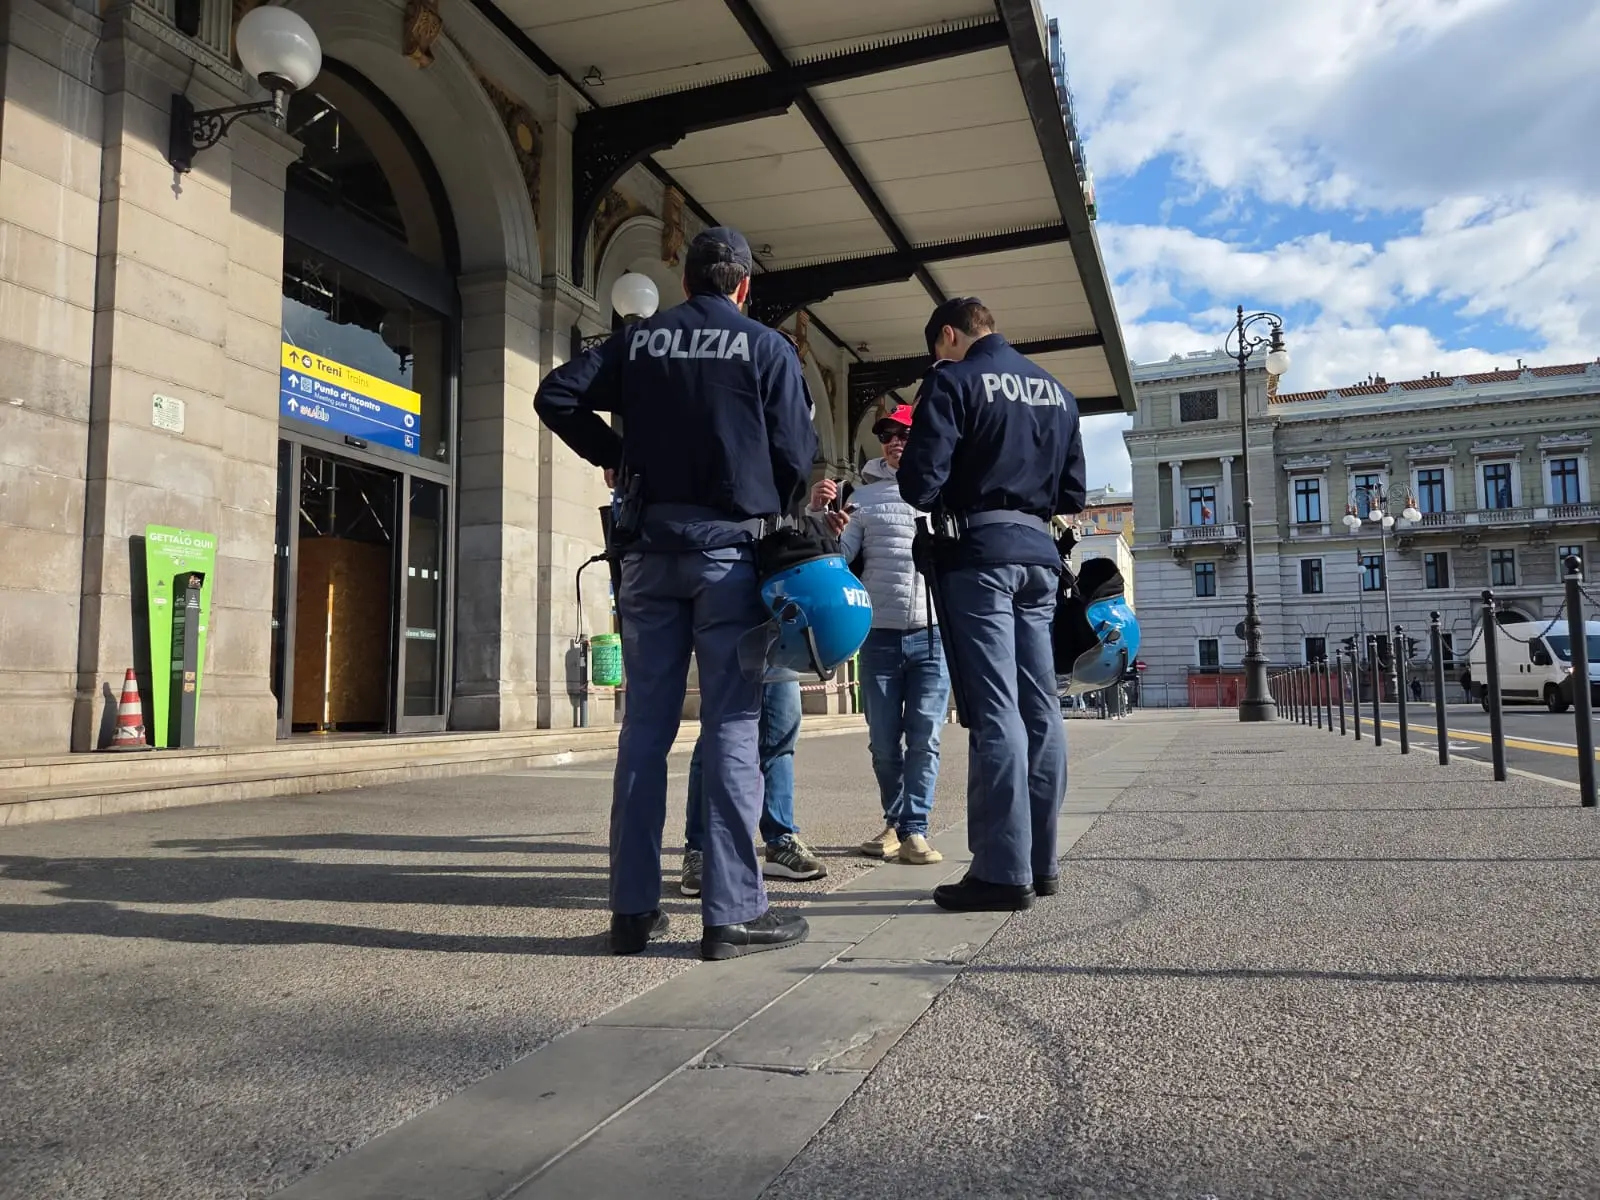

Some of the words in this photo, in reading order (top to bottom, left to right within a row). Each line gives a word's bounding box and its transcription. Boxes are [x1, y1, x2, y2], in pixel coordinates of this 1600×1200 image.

[629, 328, 750, 361] POLIZIA
[316, 359, 342, 377] Treni
[346, 370, 369, 387] Trains
[314, 381, 339, 398] Punto
[340, 391, 381, 412] d'incontro
[981, 373, 1067, 412] POLIZIA
[150, 533, 192, 546] GETTALO
